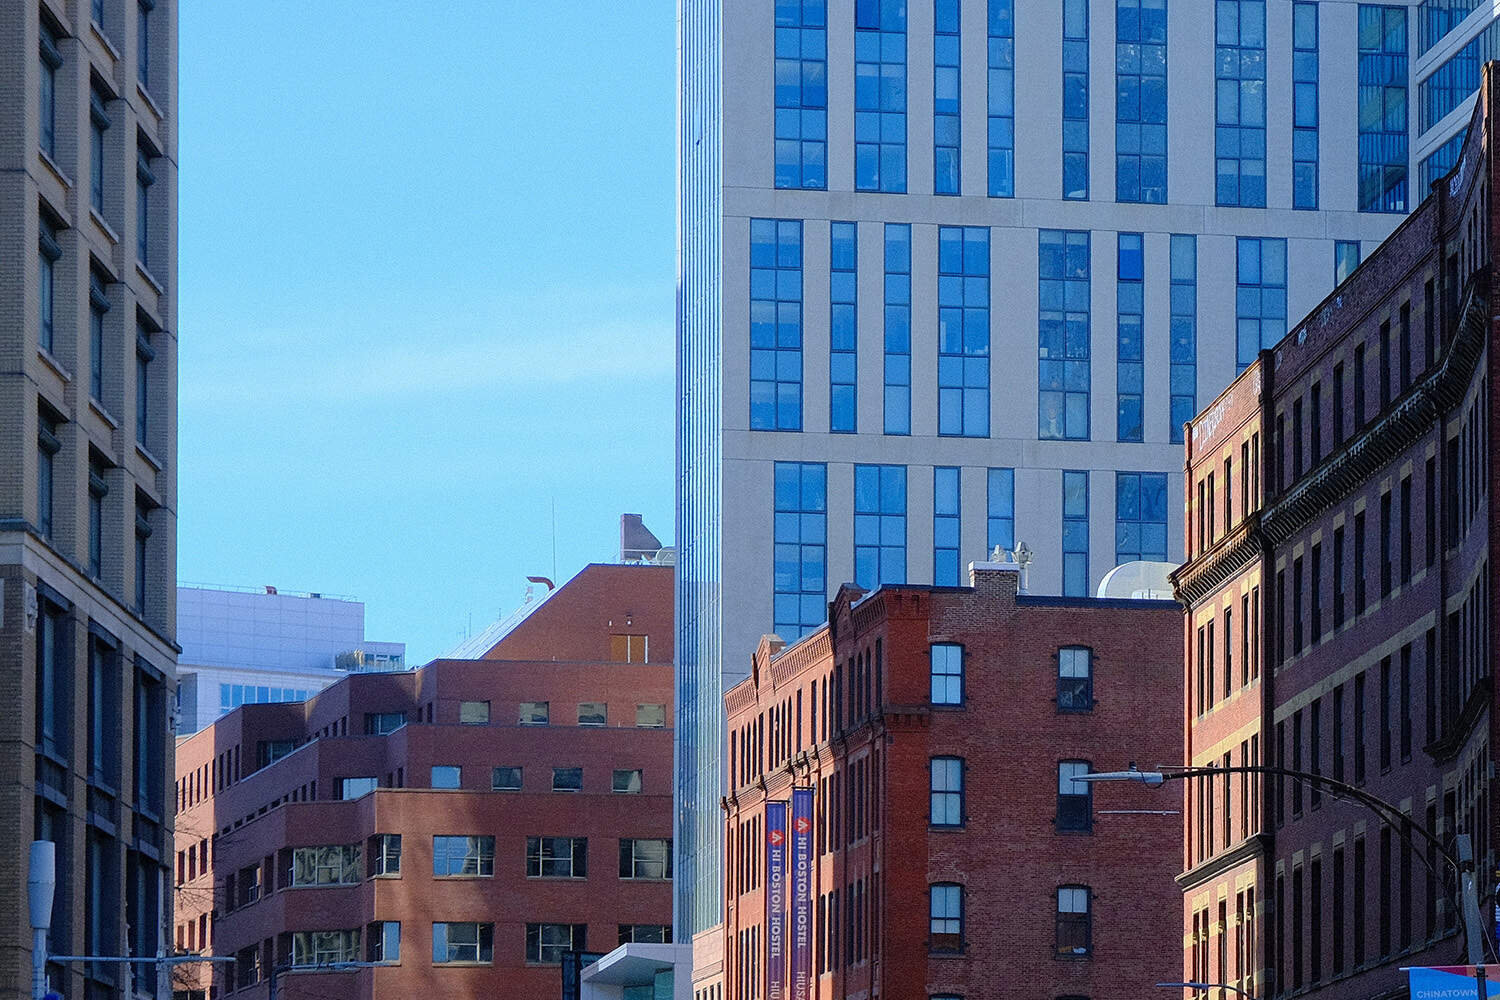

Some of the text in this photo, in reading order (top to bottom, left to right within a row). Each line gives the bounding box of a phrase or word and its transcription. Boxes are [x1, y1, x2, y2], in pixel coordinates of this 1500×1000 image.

[772, 849, 782, 863] HI
[797, 836, 808, 849] HI
[771, 864, 782, 912] BOSTON
[797, 852, 808, 901] BOSTON
[771, 914, 781, 959] HOSTEL
[797, 903, 807, 949] HOSTEL
[1416, 989, 1479, 999] CHINATOWN
